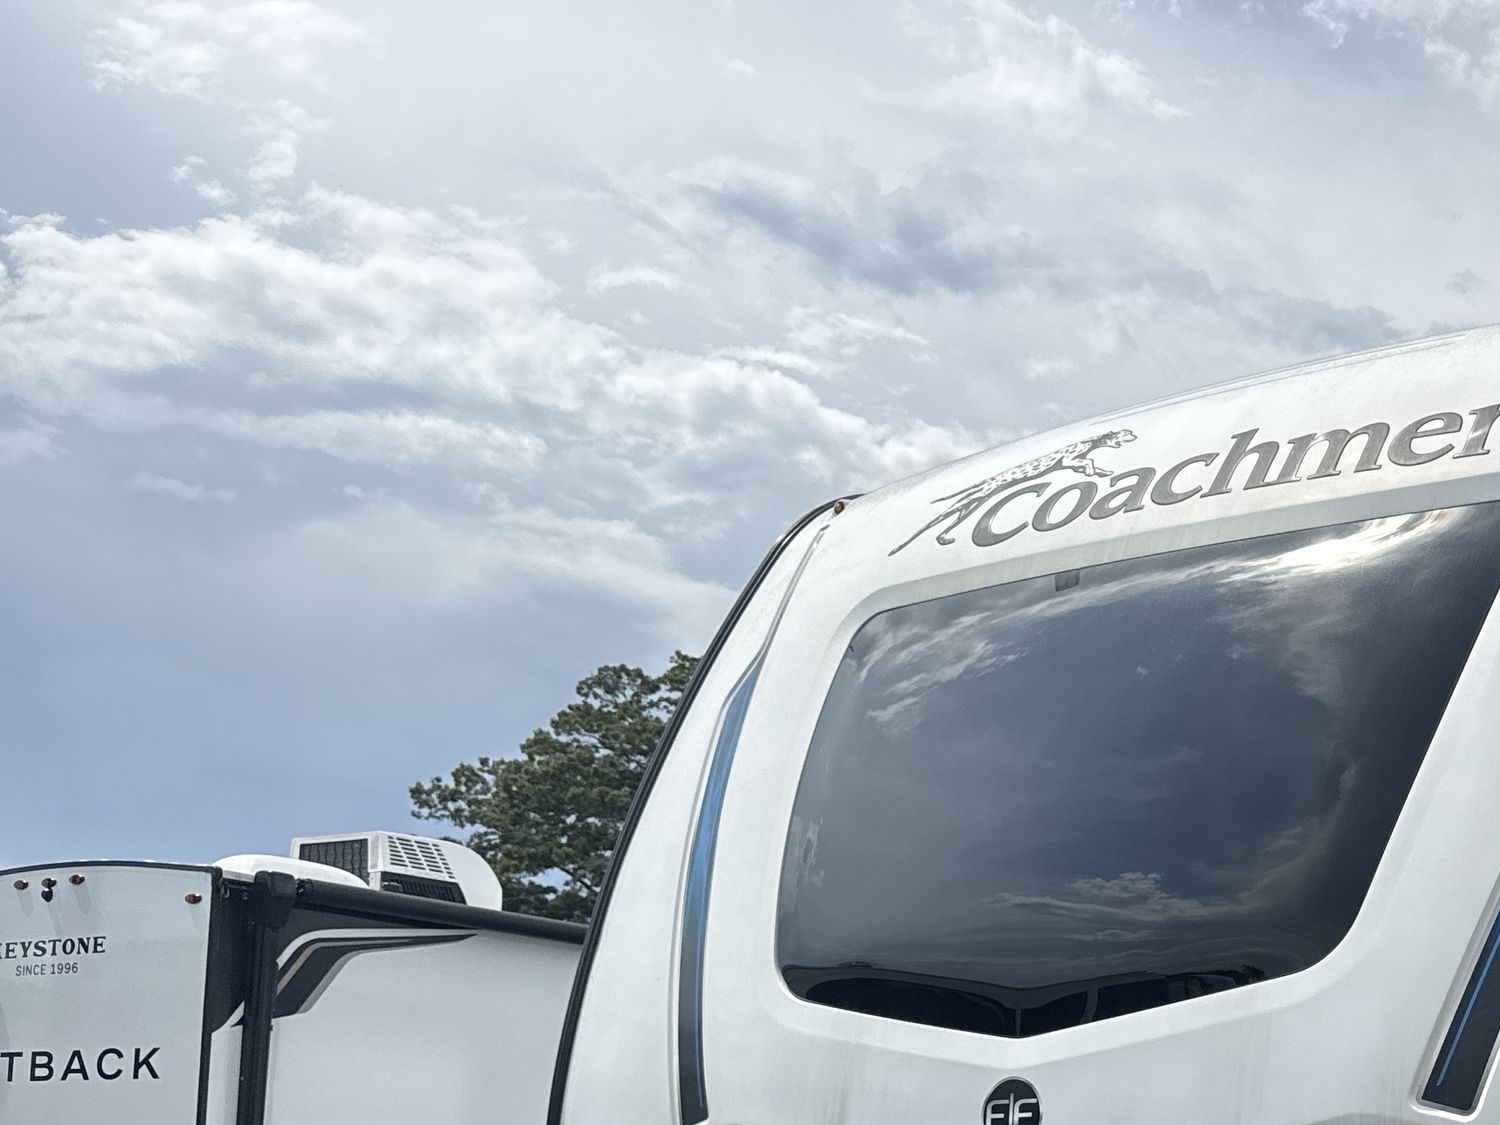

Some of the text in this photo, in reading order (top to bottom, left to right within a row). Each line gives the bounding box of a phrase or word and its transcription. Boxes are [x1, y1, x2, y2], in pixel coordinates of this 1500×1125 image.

[0, 936, 107, 960] EYSTONE
[15, 962, 79, 977] SINCE 1996
